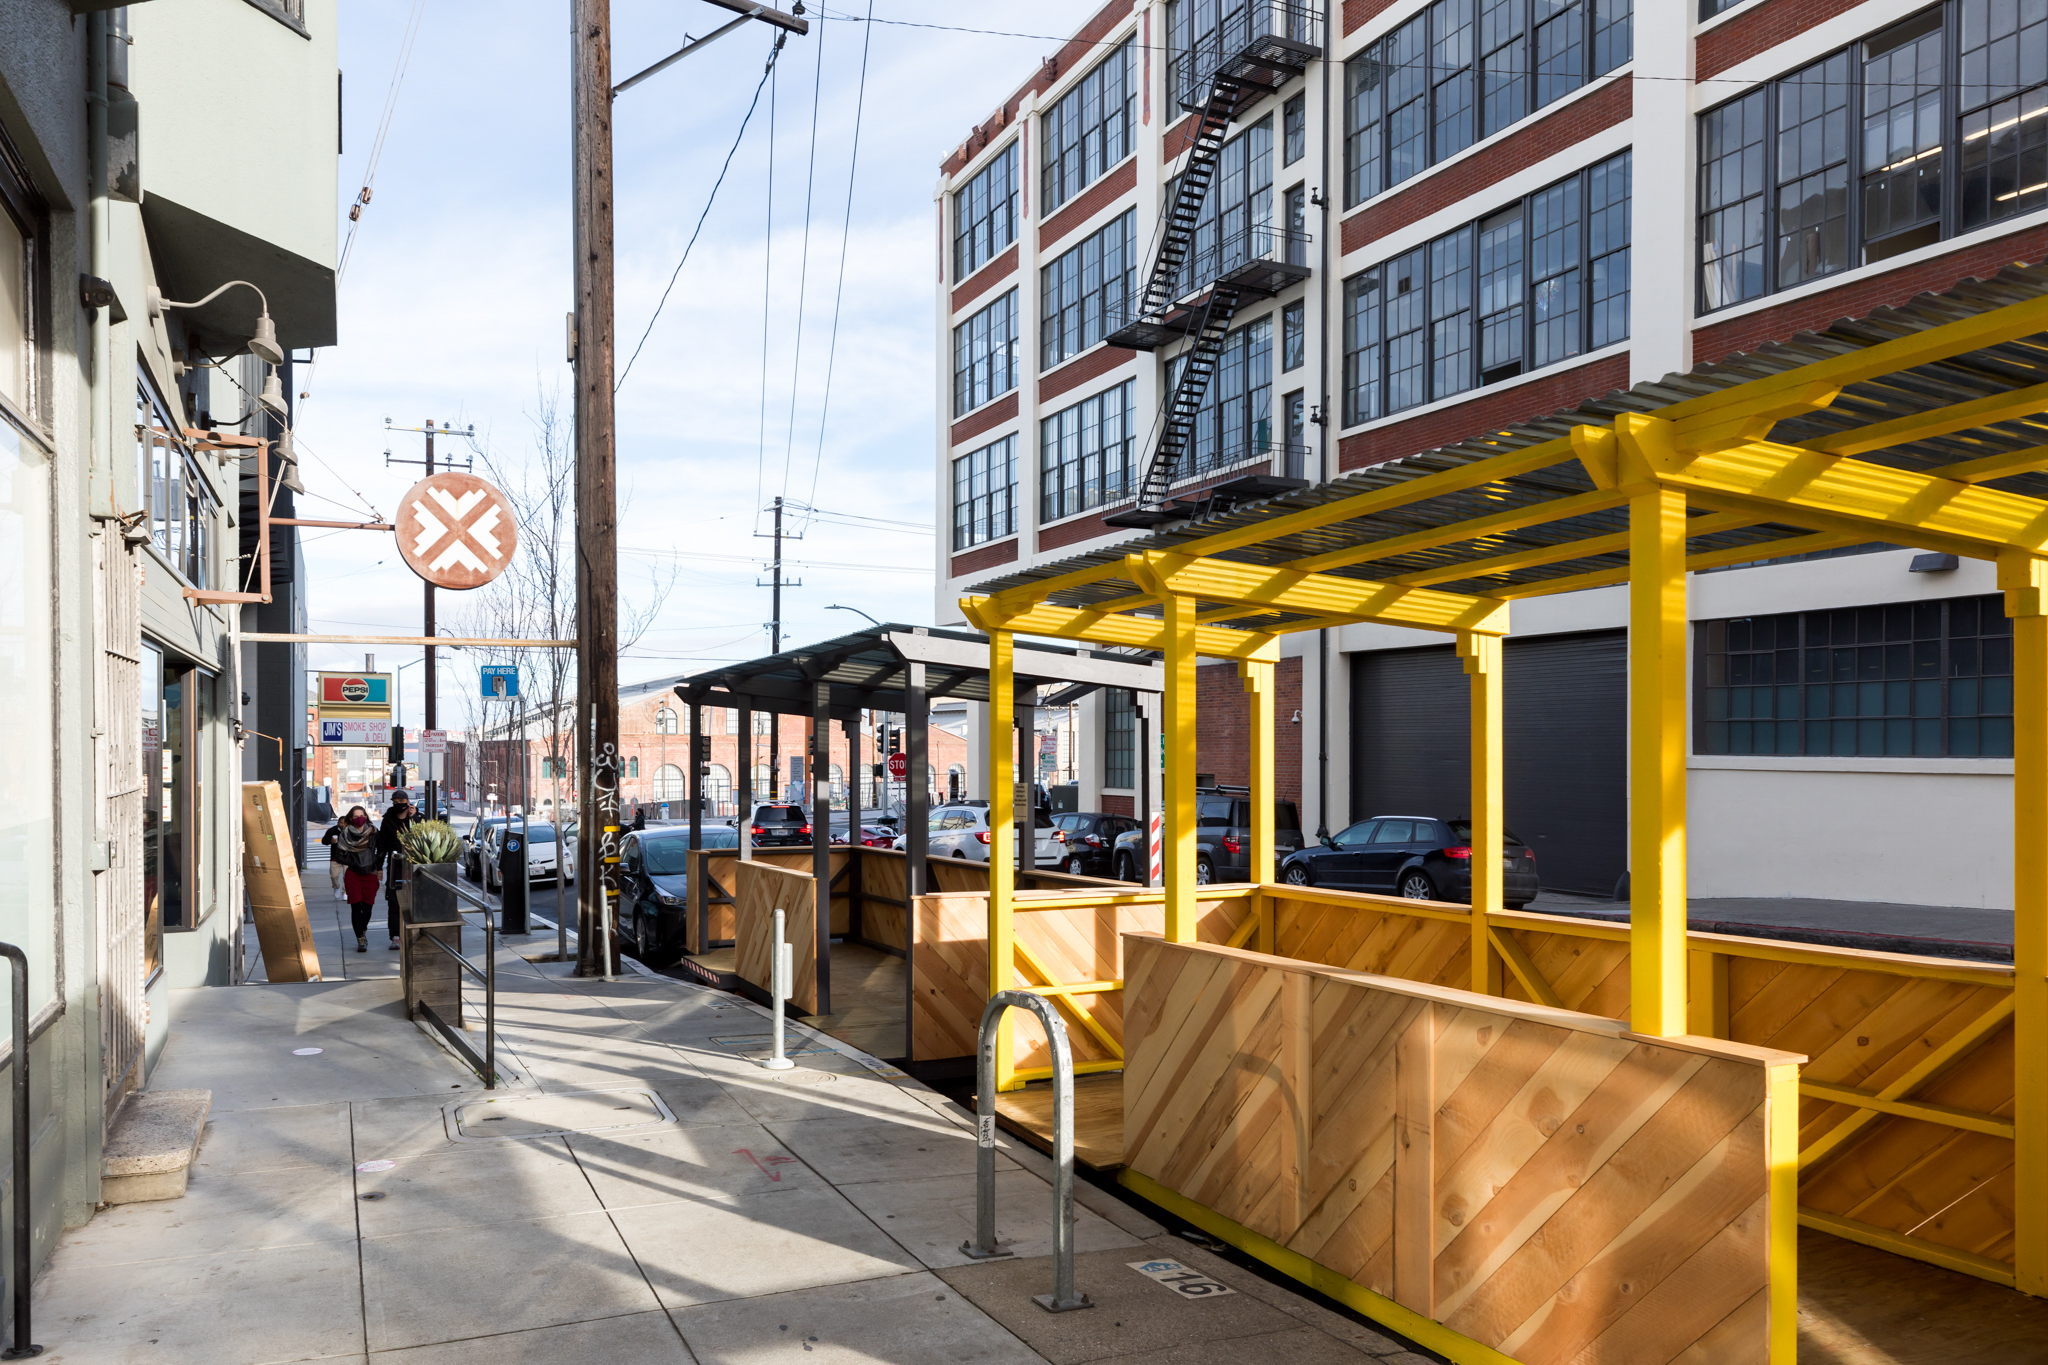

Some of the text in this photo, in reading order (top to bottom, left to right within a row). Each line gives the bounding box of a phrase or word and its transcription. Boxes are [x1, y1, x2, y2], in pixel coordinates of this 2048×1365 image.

[482, 667, 516, 675] PAY HERE
[324, 722, 342, 736] JIM'S
[343, 722, 387, 732] SMOKE SHOP
[365, 733, 387, 742] & DELI
[890, 760, 906, 769] STO
[510, 841, 517, 849] P
